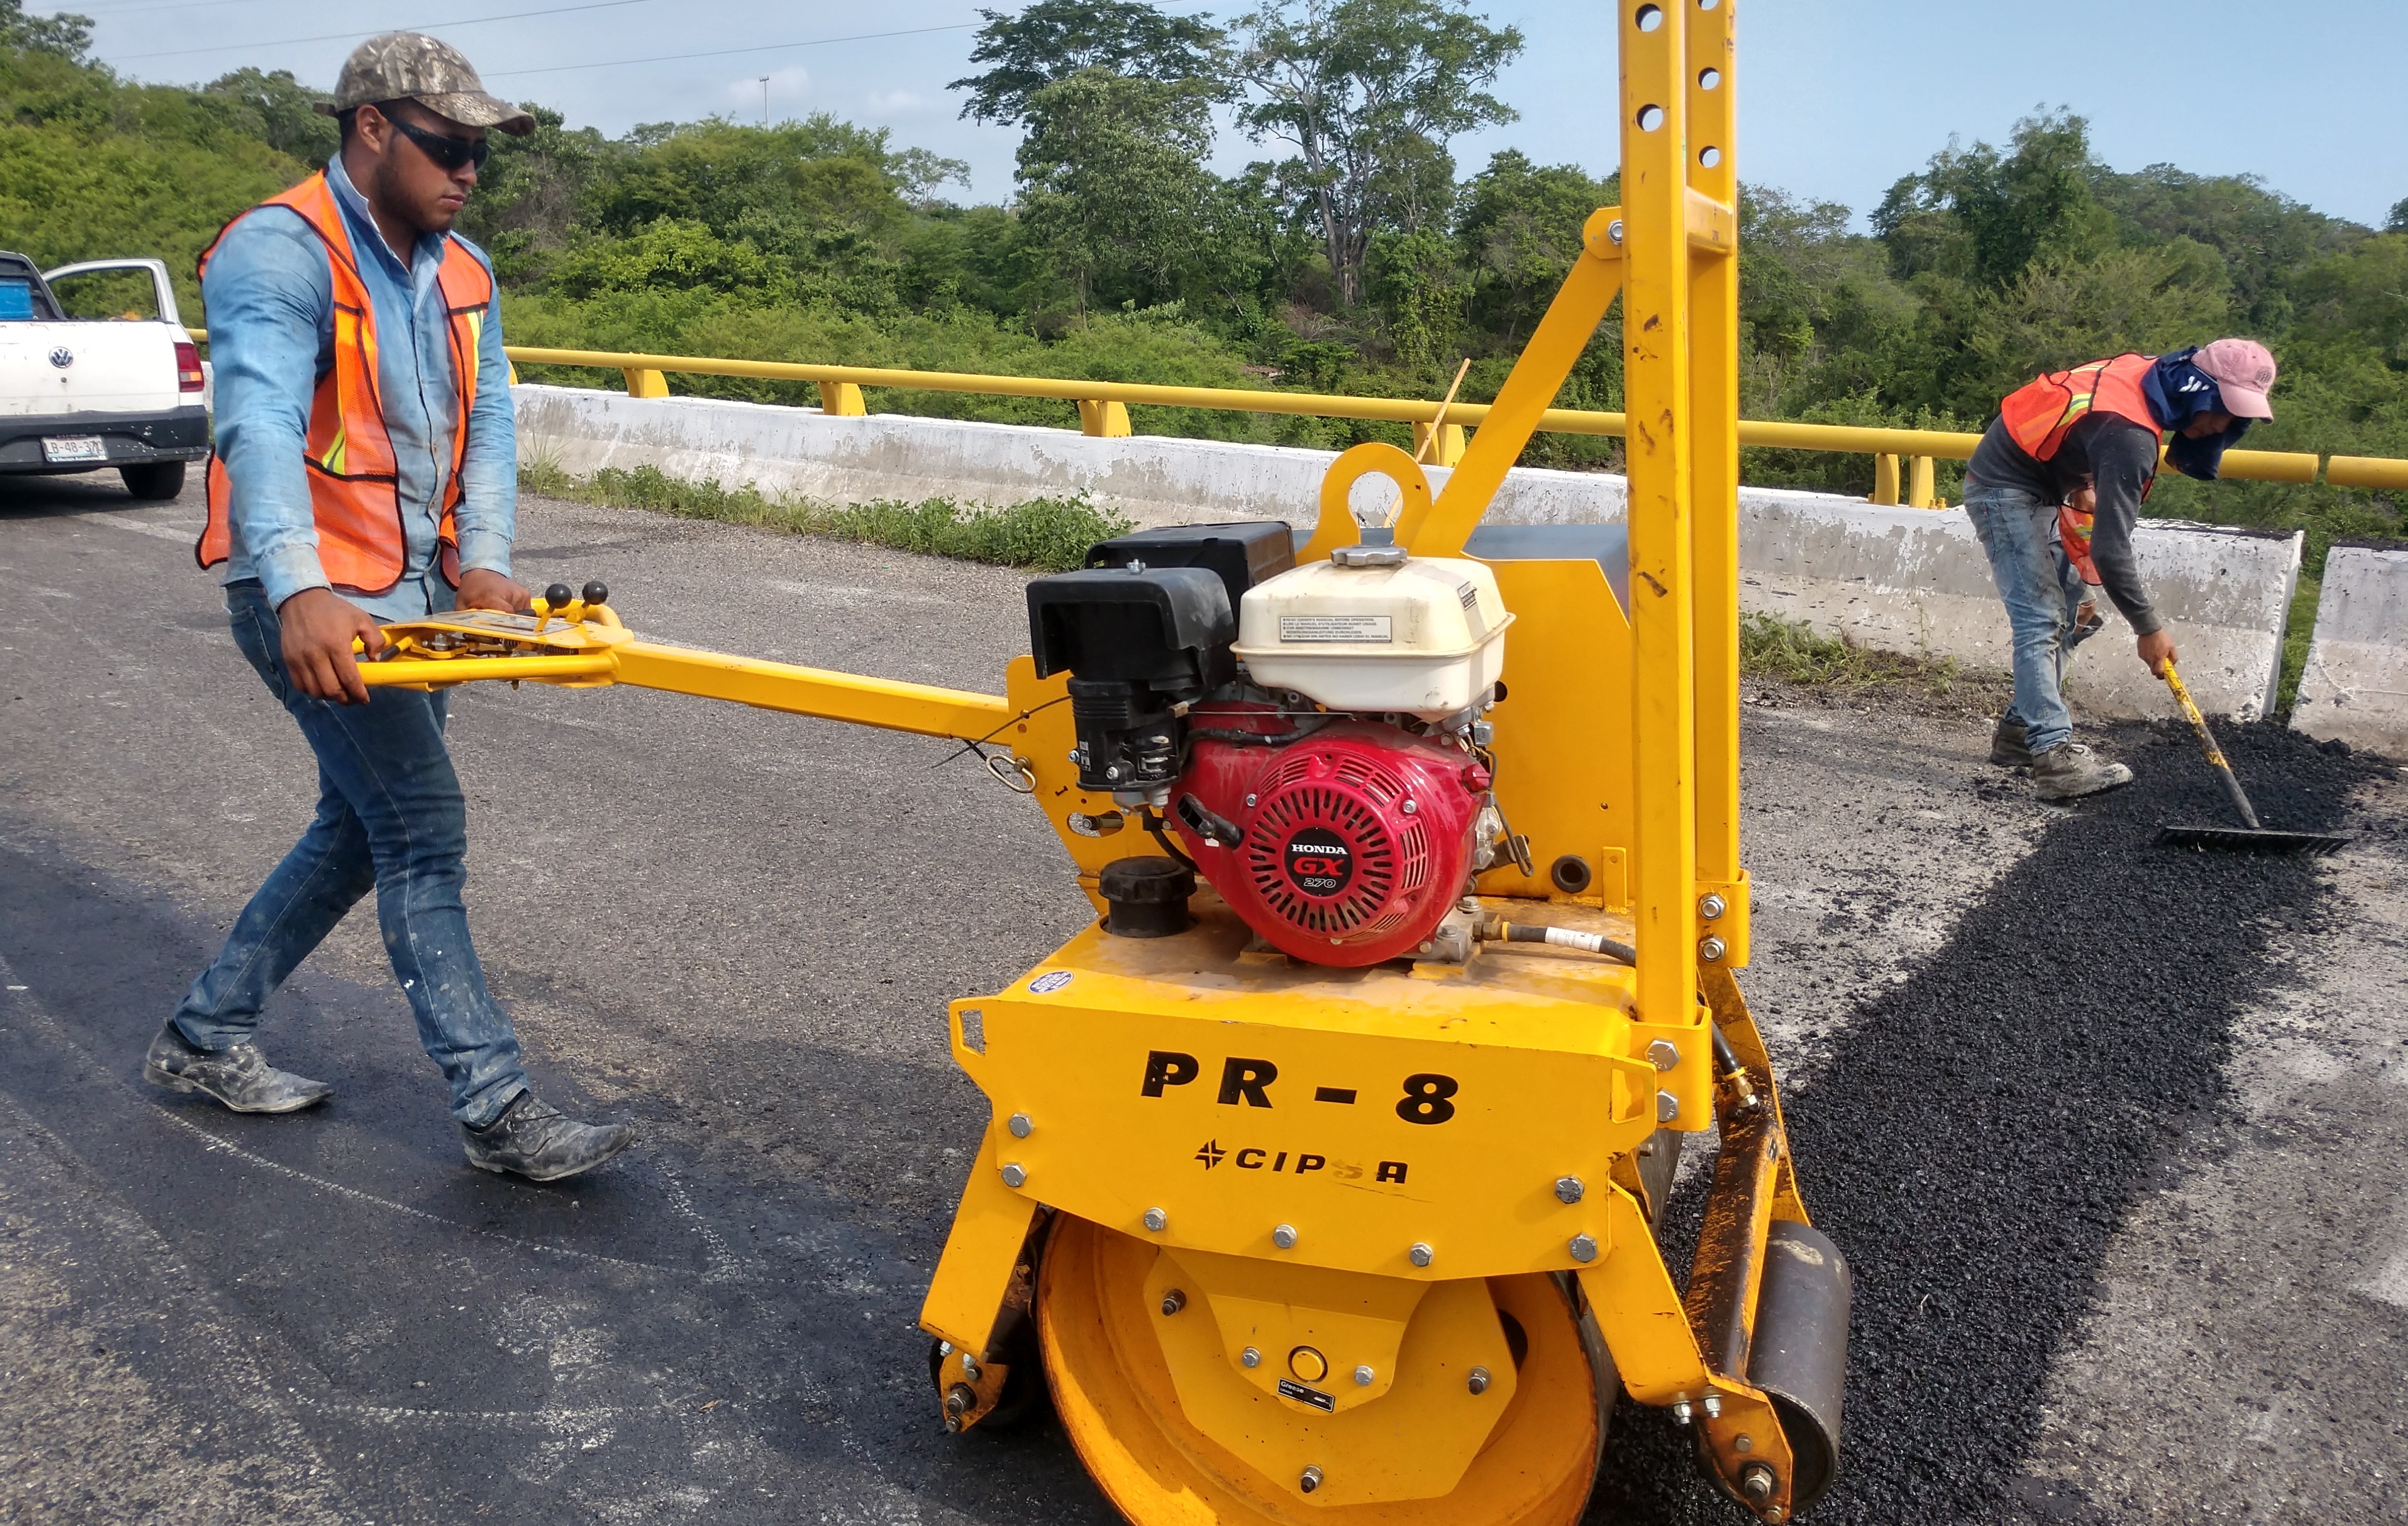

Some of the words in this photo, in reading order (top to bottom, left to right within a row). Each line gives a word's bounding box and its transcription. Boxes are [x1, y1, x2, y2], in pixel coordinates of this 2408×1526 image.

[1291, 844, 1348, 854] HONDA
[1294, 857, 1344, 876] GX
[1304, 878, 1336, 888] 270
[1281, 1381, 1304, 1393] Grease
